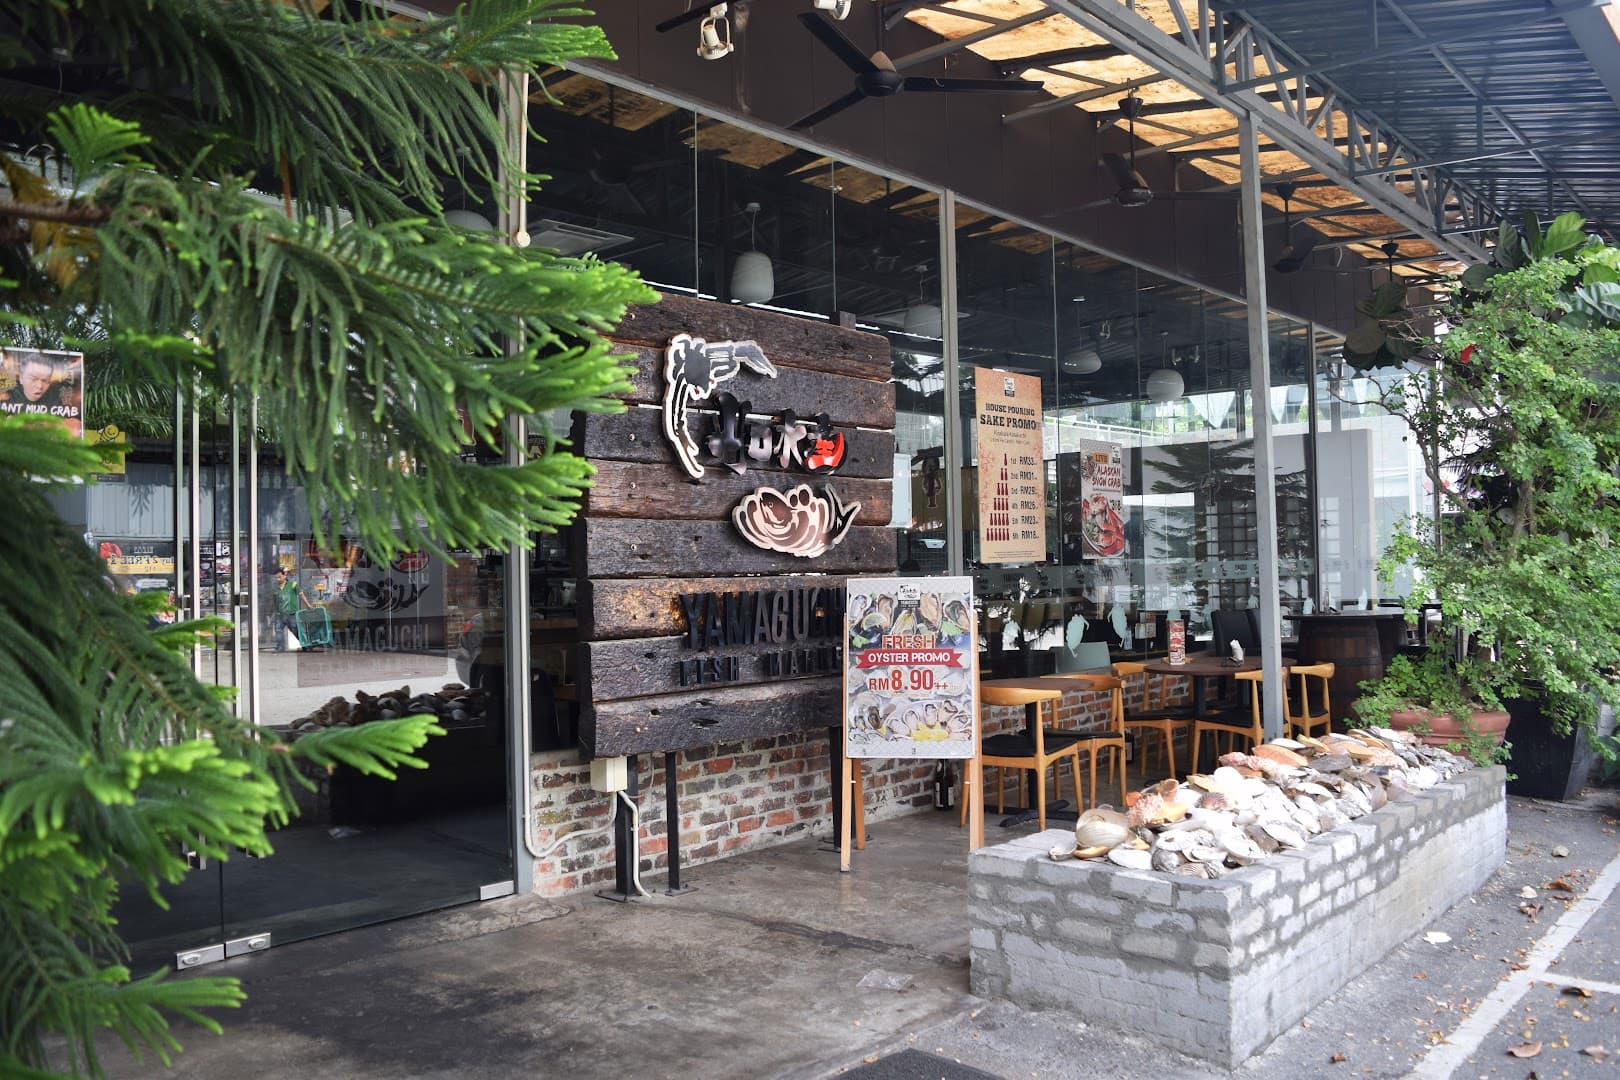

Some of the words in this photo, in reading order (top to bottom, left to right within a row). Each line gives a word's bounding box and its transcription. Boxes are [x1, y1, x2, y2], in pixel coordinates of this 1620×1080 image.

[25, 403, 48, 414] MUD
[50, 405, 79, 417] CRAB
[986, 402, 1007, 413] HOUSE
[1007, 406, 1035, 416] POURING
[980, 414, 1005, 426] SAKE
[882, 634, 935, 648] FRESH
[868, 652, 909, 663] OYSTER
[911, 652, 951, 662] PROMO
